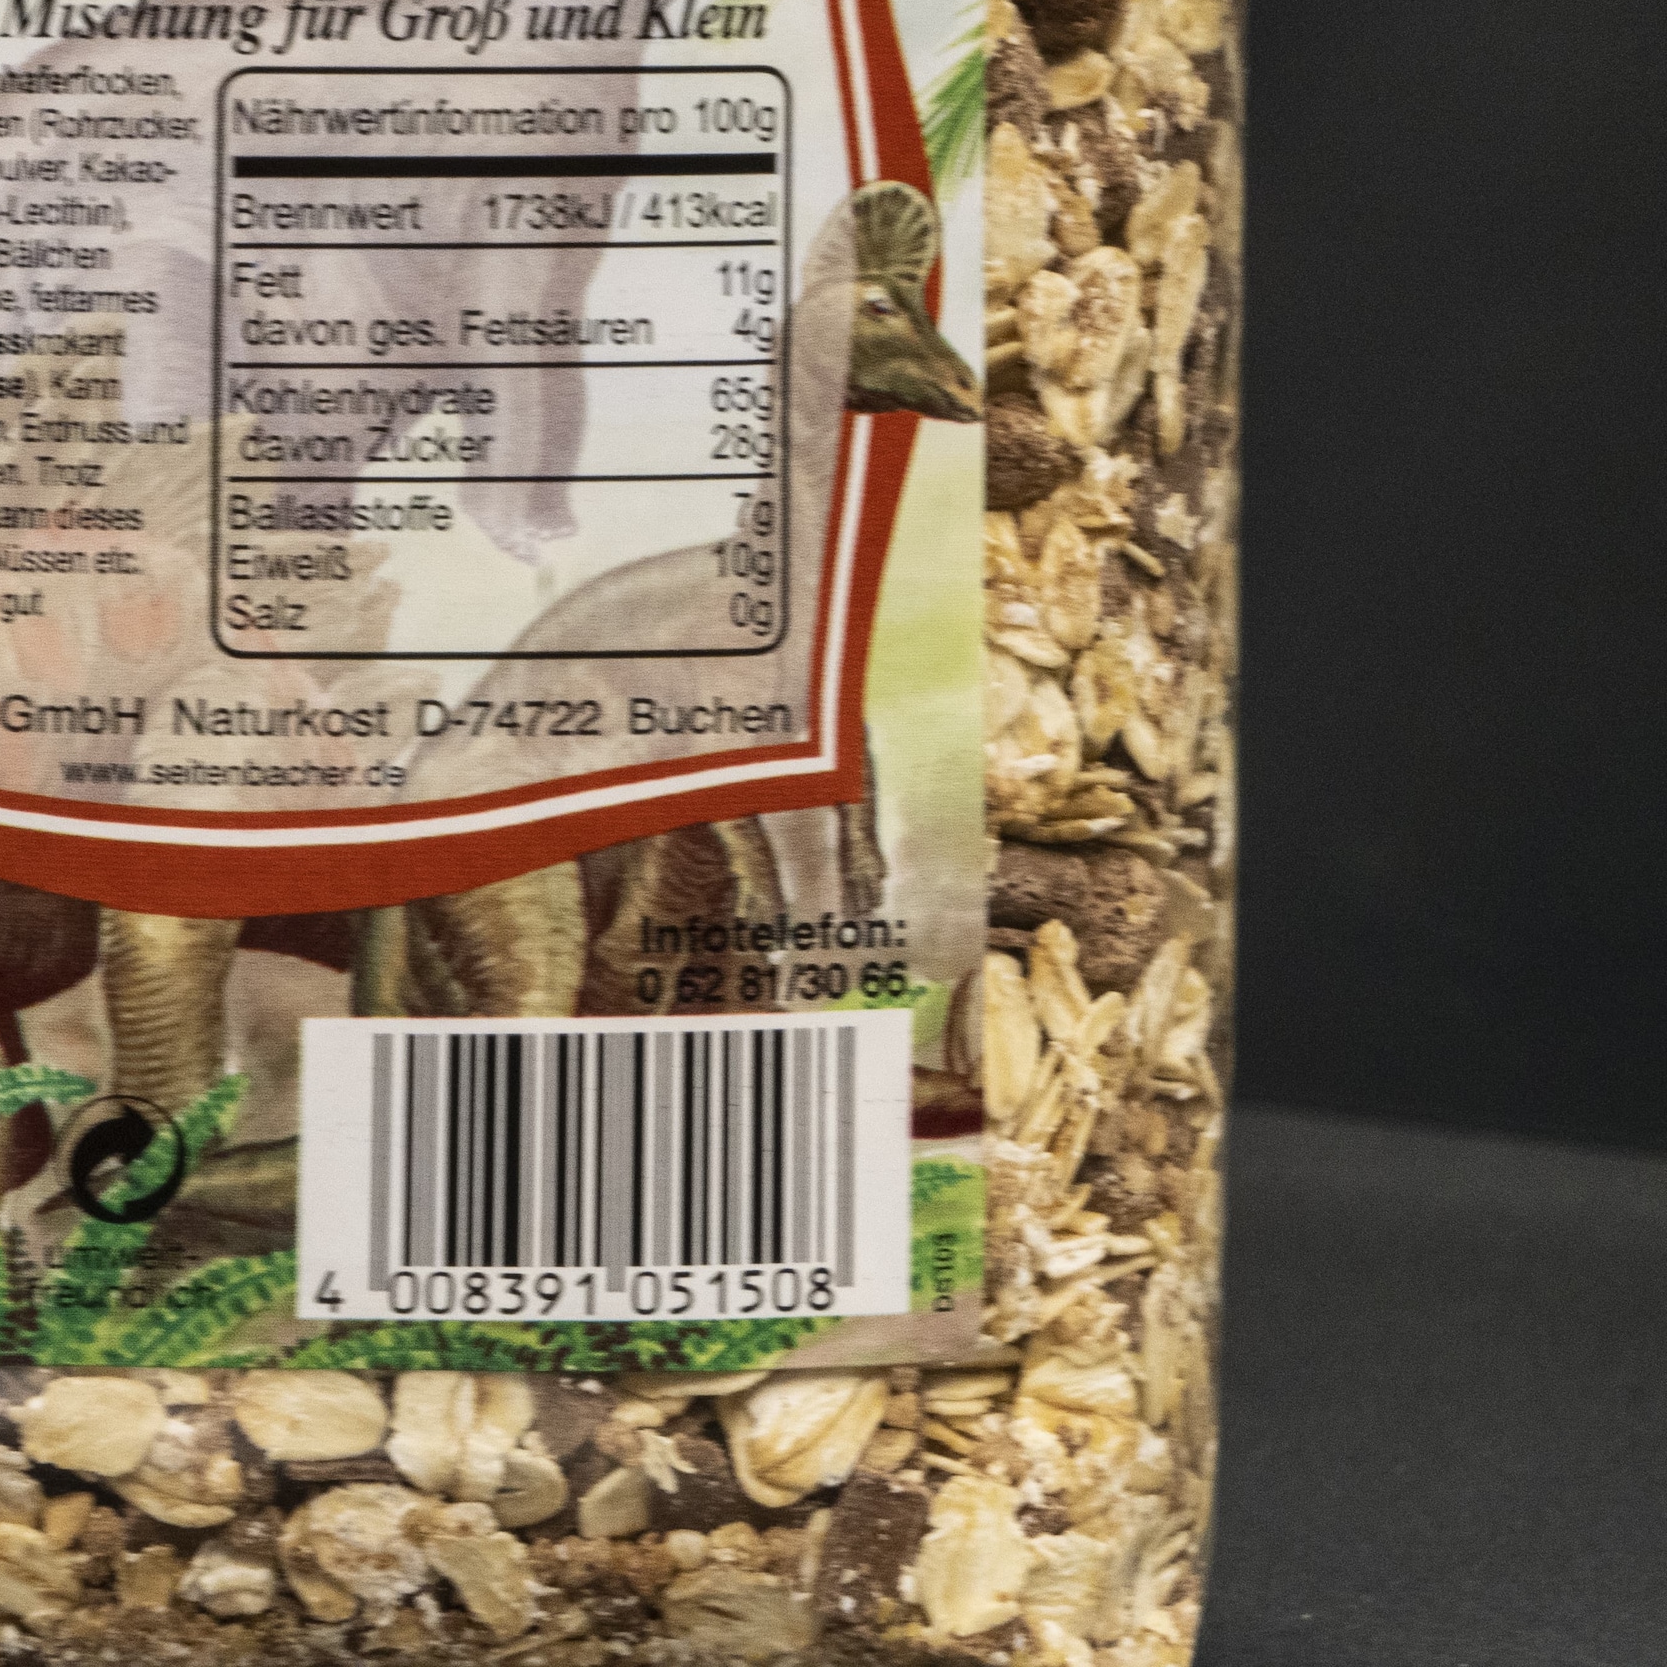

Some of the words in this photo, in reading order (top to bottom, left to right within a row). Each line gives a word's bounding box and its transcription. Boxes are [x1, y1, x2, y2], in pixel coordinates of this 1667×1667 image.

[232, 96, 604, 136] Nährwertinformation
[616, 105, 678, 144] pro
[692, 97, 778, 142] 100g
[230, 192, 425, 231] Brennwert
[481, 192, 614, 231] 1738kJ
[640, 190, 777, 230] 413kcal
[229, 260, 304, 299] Fett
[716, 260, 777, 305] 11g
[241, 310, 357, 347] davon
[369, 317, 447, 356] ges.
[457, 307, 655, 347] Fettsäuren
[731, 308, 776, 353] 4g
[226, 378, 498, 426] Kohlenhydrate
[708, 376, 775, 419] 65g
[239, 426, 355, 463] davon
[365, 425, 495, 463] Zucker
[708, 423, 775, 469] 28g
[226, 493, 454, 532] Ballaststoffe
[225, 543, 354, 581] Eiweiß
[713, 542, 776, 586] 10g
[225, 593, 309, 632] Salz
[727, 591, 775, 638] 0g
[172, 696, 391, 740] Naturkost
[415, 698, 603, 738] D-74722
[627, 697, 793, 738] Buchen
[638, 912, 908, 956] Infotelefon:
[636, 966, 659, 1005] 0
[676, 965, 726, 1001] 62
[737, 961, 848, 1001] 81/30
[857, 960, 908, 999] 66
[313, 1268, 345, 1307] 4
[385, 1270, 599, 1317] 008391
[628, 1266, 838, 1314] 051508
